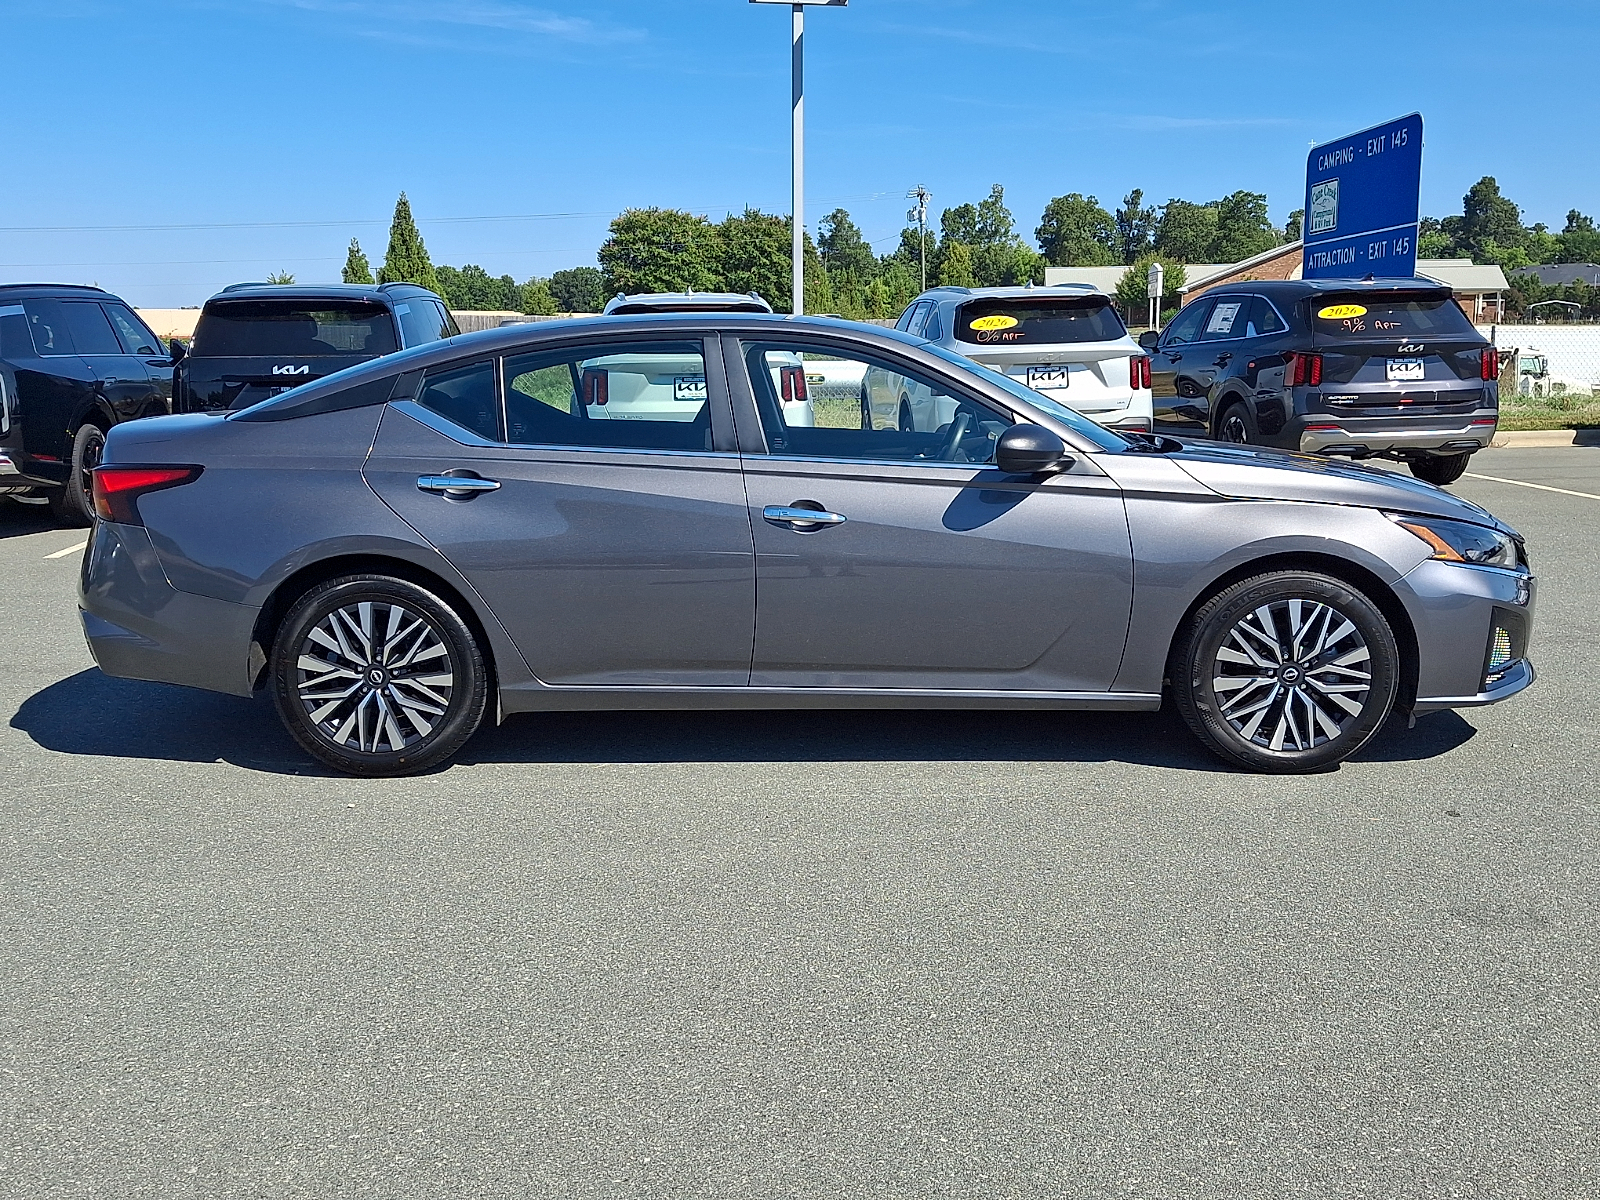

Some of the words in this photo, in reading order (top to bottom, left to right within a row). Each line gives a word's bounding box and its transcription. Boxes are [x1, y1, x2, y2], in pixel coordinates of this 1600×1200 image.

[1318, 146, 1354, 171] CAMPING
[1367, 135, 1386, 157] EXIT
[1391, 127, 1408, 150] 145
[1308, 246, 1356, 270] ATTRACTION
[1368, 241, 1388, 260] EXIT
[1392, 237, 1410, 256] 145
[1326, 306, 1358, 317] 2026
[977, 318, 1008, 328] 2026
[1397, 344, 1425, 353] KIA
[272, 364, 309, 375] KIA
[1389, 363, 1422, 372] KIA
[1031, 371, 1066, 381] KIA
